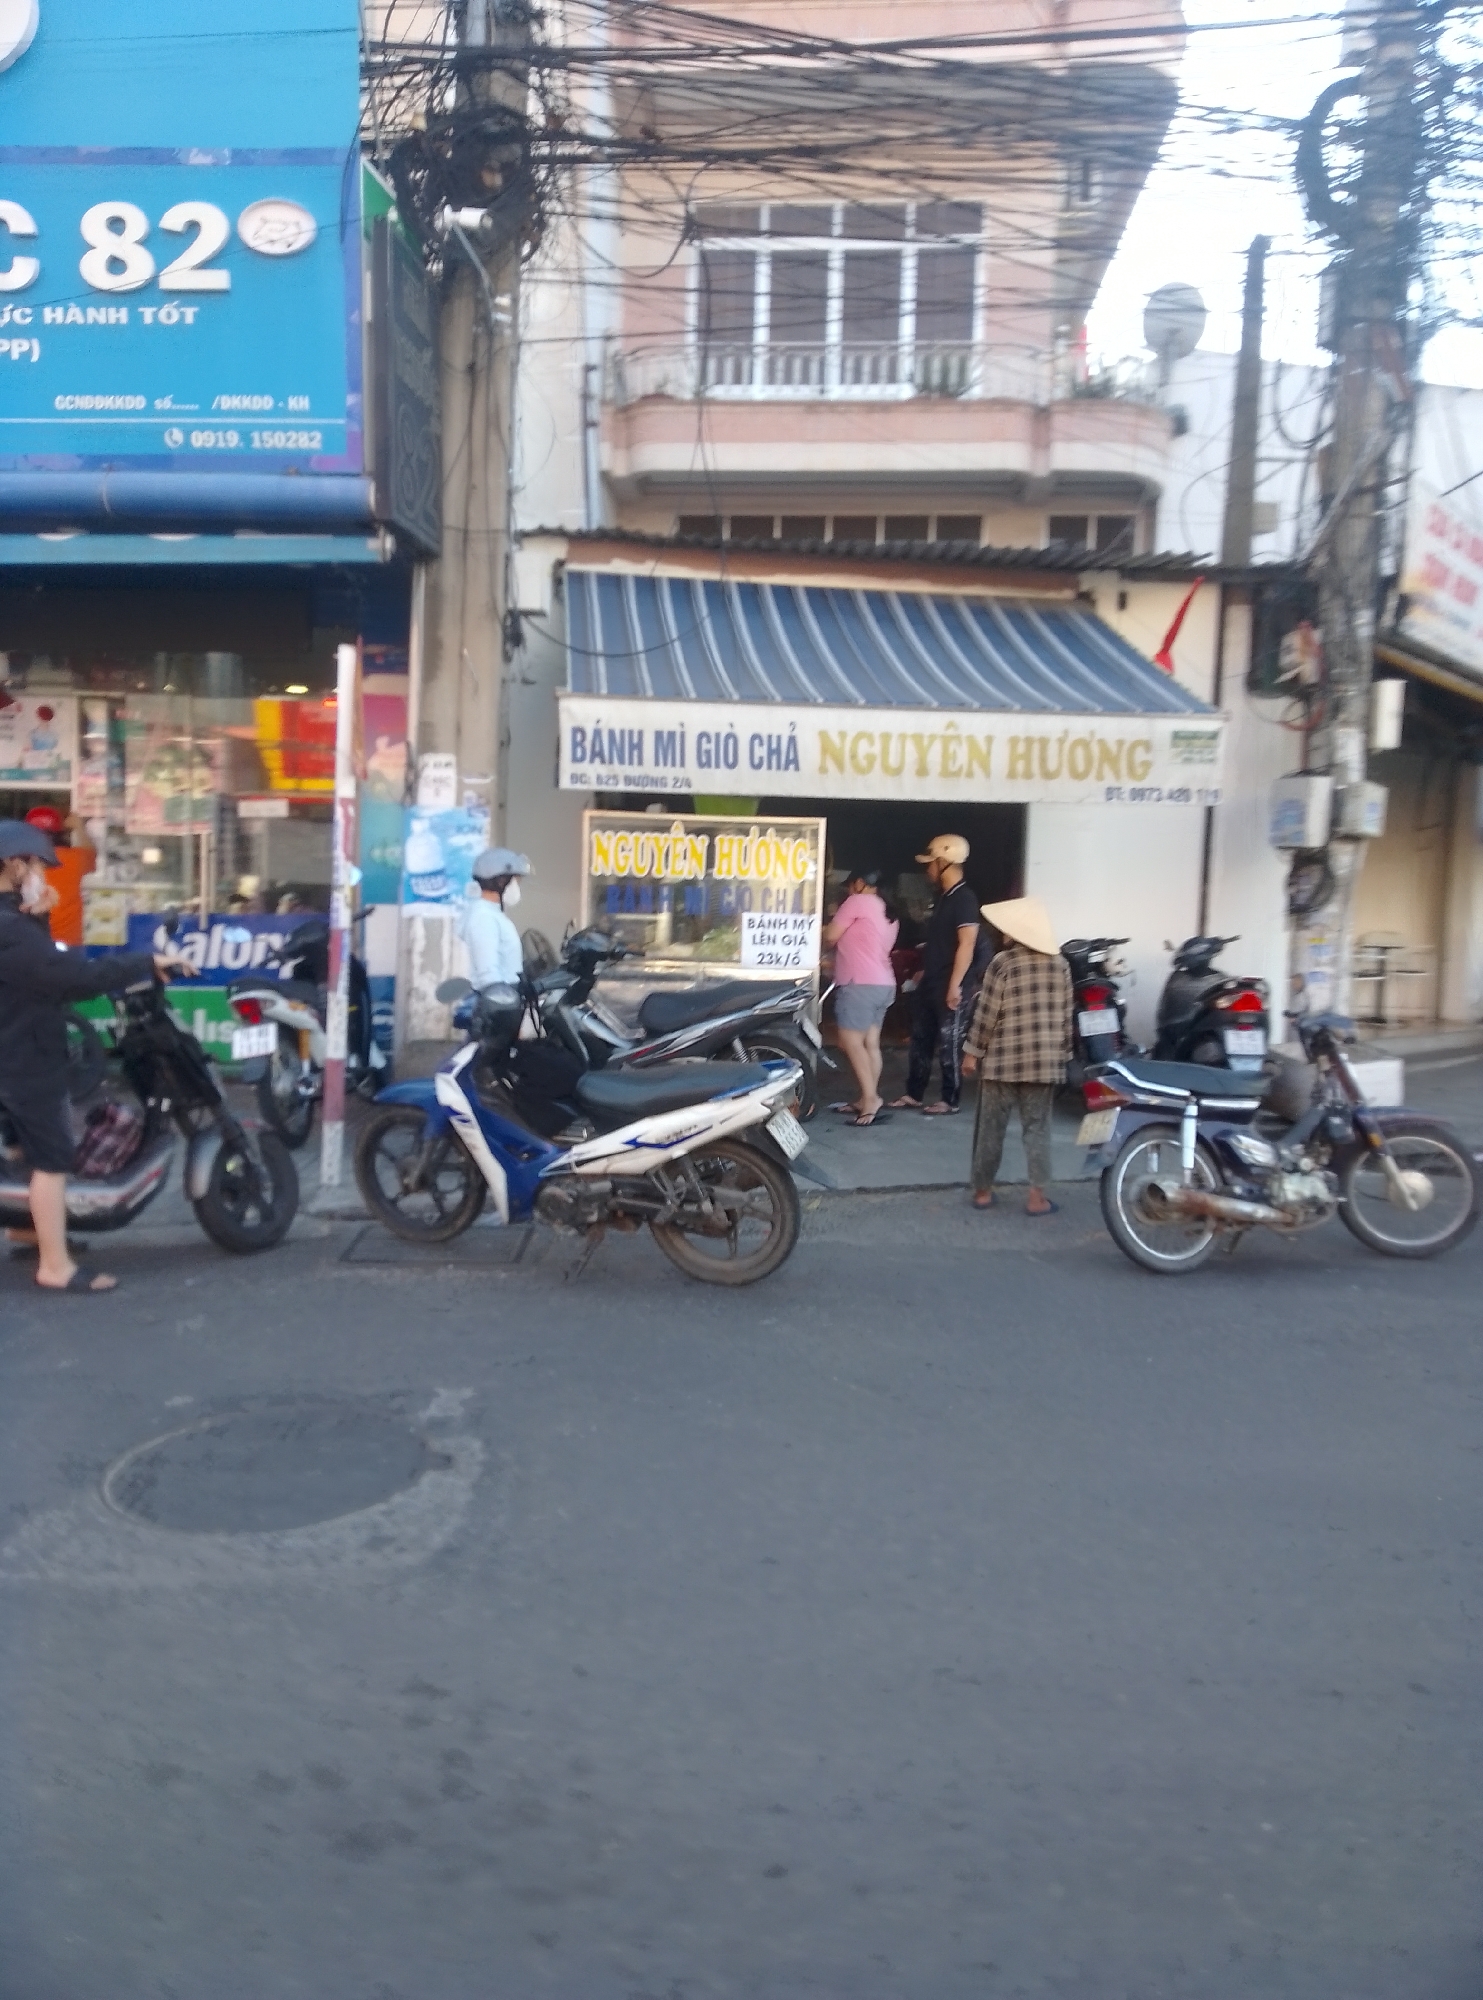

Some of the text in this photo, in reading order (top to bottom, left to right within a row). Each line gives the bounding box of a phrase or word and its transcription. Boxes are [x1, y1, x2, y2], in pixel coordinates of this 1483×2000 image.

[79, 200, 231, 292] 82
[43, 302, 129, 325] HÀNH
[138, 300, 200, 325] TỐT
[570, 719, 800, 772] BÁNH MÌ GIÒ CHẢ
[817, 720, 994, 779] NGUYÊN
[1005, 728, 1153, 782] HƯƠNG
[590, 820, 811, 882] NGUYÊN HƯƠNG
[747, 914, 788, 930] BÁNH
[752, 932, 808, 947] LÊN GIÁ
